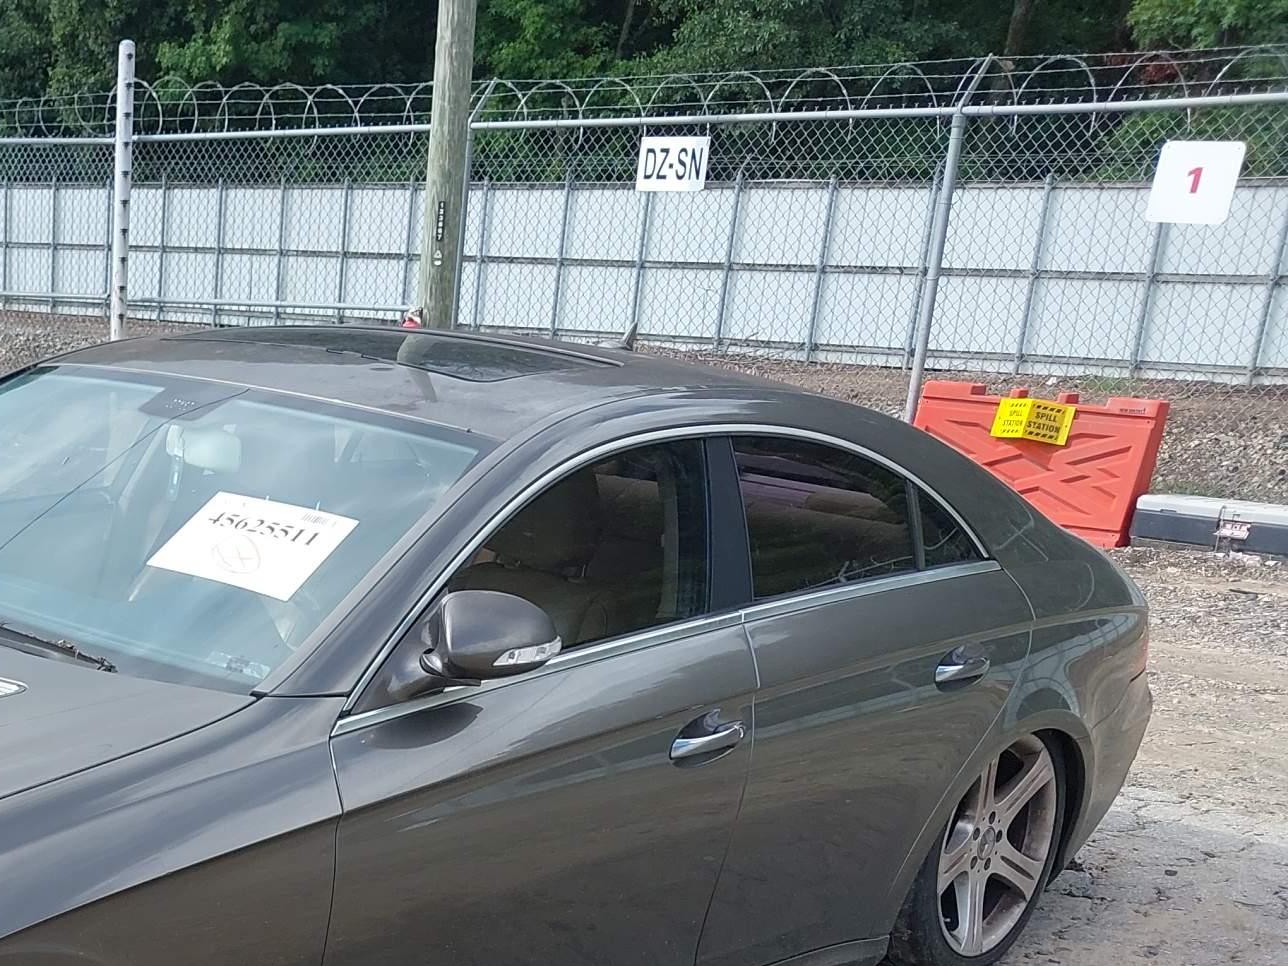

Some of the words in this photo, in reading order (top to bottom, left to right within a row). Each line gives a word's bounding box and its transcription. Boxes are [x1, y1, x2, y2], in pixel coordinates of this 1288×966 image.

[643, 147, 703, 180] DZ-SN
[1187, 167, 1203, 194] 1
[1027, 420, 1061, 434] STATION
[1035, 411, 1058, 423] SPILL
[208, 511, 320, 546] 45625511
